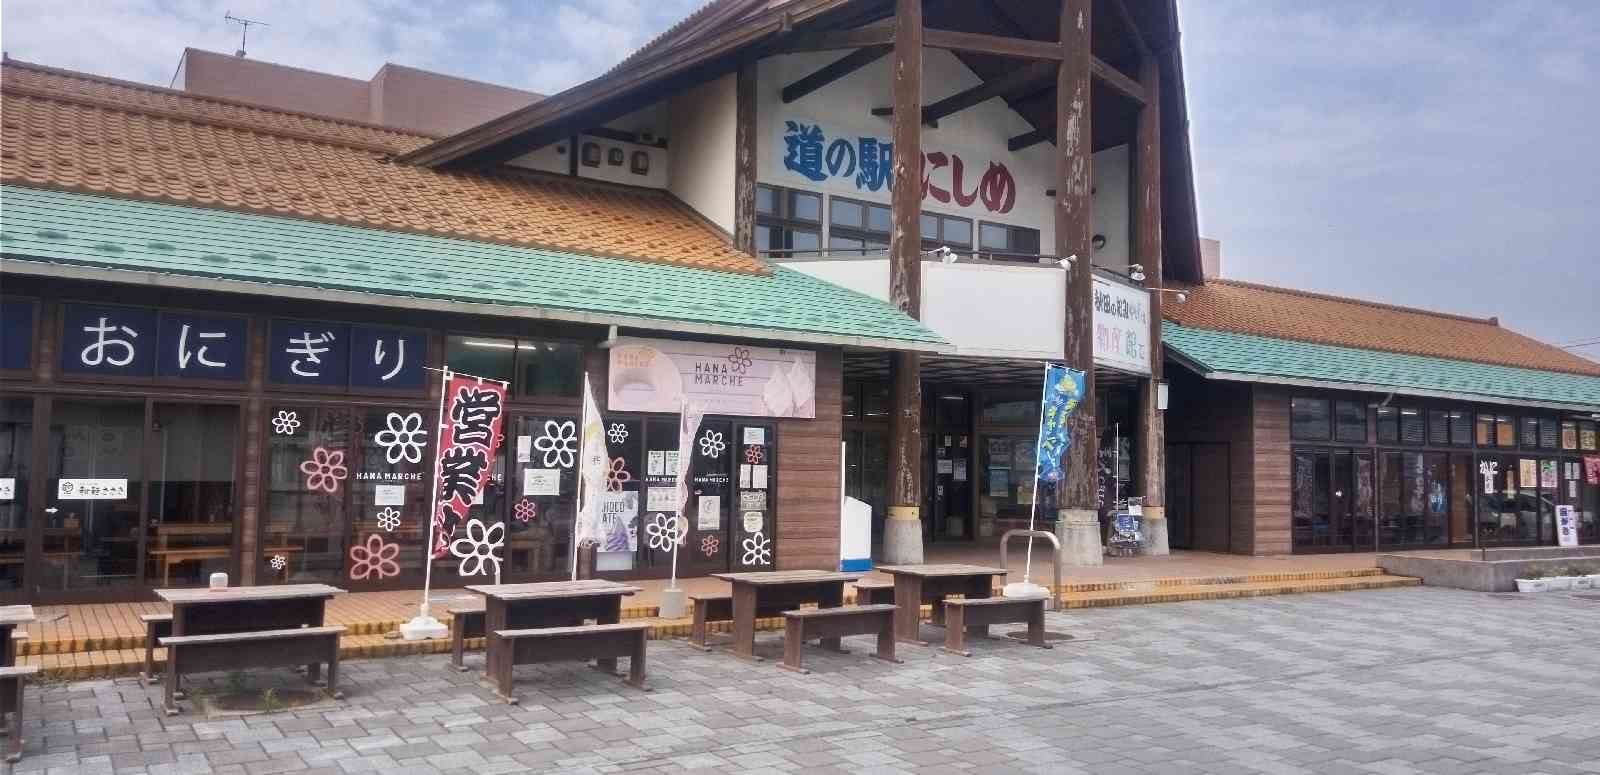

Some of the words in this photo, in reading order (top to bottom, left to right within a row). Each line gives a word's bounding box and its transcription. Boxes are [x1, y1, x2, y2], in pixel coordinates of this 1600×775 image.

[783, 119, 893, 192] 道の駅
[919, 152, 1016, 215] にしめ
[80, 317, 408, 381] おにぎり
[695, 361, 728, 374] HANA
[695, 373, 745, 387] MARCHE
[356, 472, 383, 480] HANA
[384, 472, 423, 480] MARCHE
